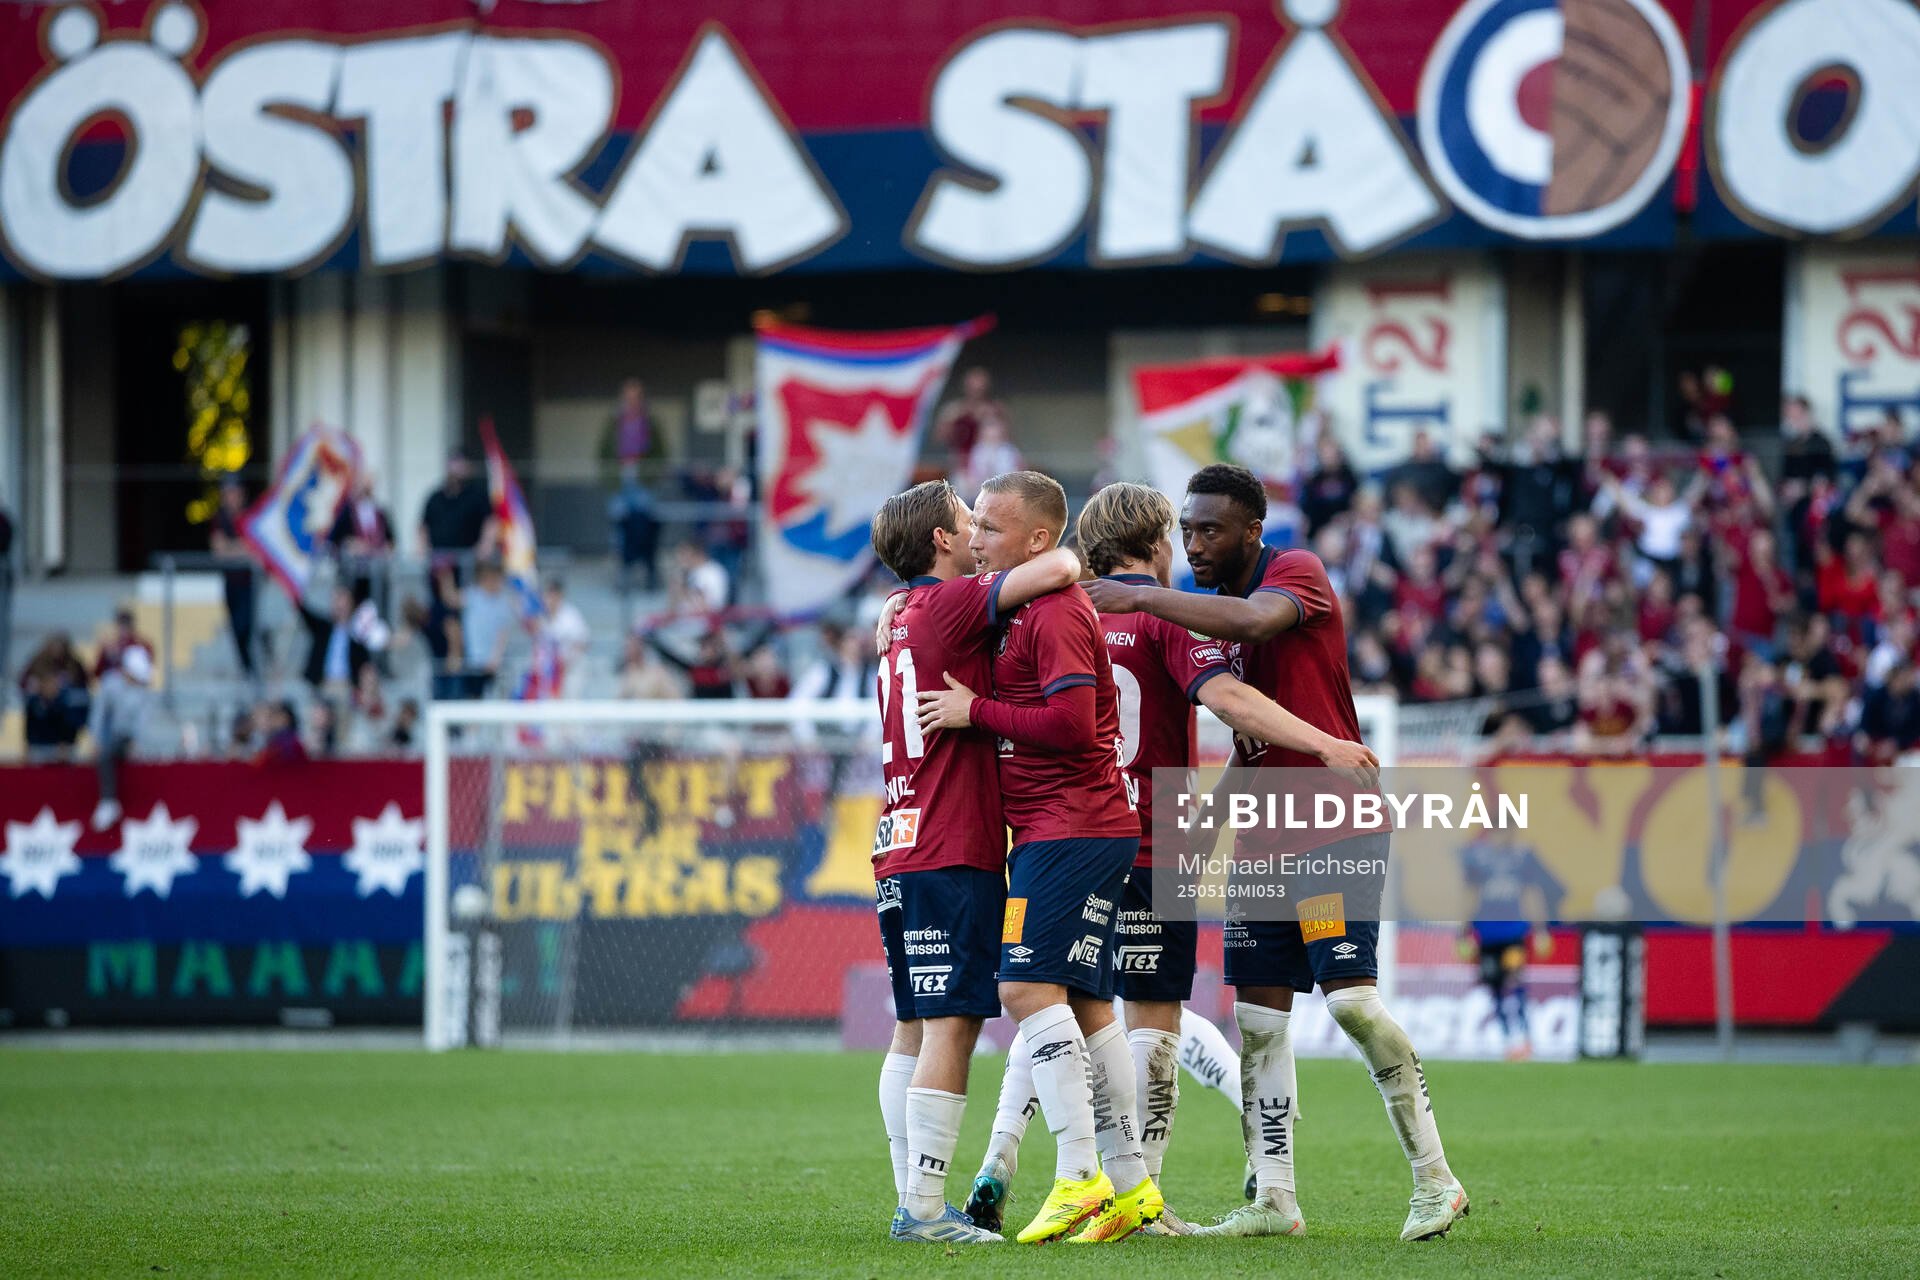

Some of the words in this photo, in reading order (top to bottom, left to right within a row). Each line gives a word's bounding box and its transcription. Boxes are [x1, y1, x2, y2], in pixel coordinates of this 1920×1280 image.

[0, 4, 846, 280] ÖSTRA
[905, 0, 1450, 267] STÅ
[1301, 902, 1337, 920] TRIUMF
[1304, 918, 1335, 934] GLASS
[1183, 1036, 1228, 1087] MIKE
[1120, 1114, 1134, 1142] umbro
[1141, 1078, 1174, 1142] MIKE
[1258, 1096, 1291, 1155] MIKE
